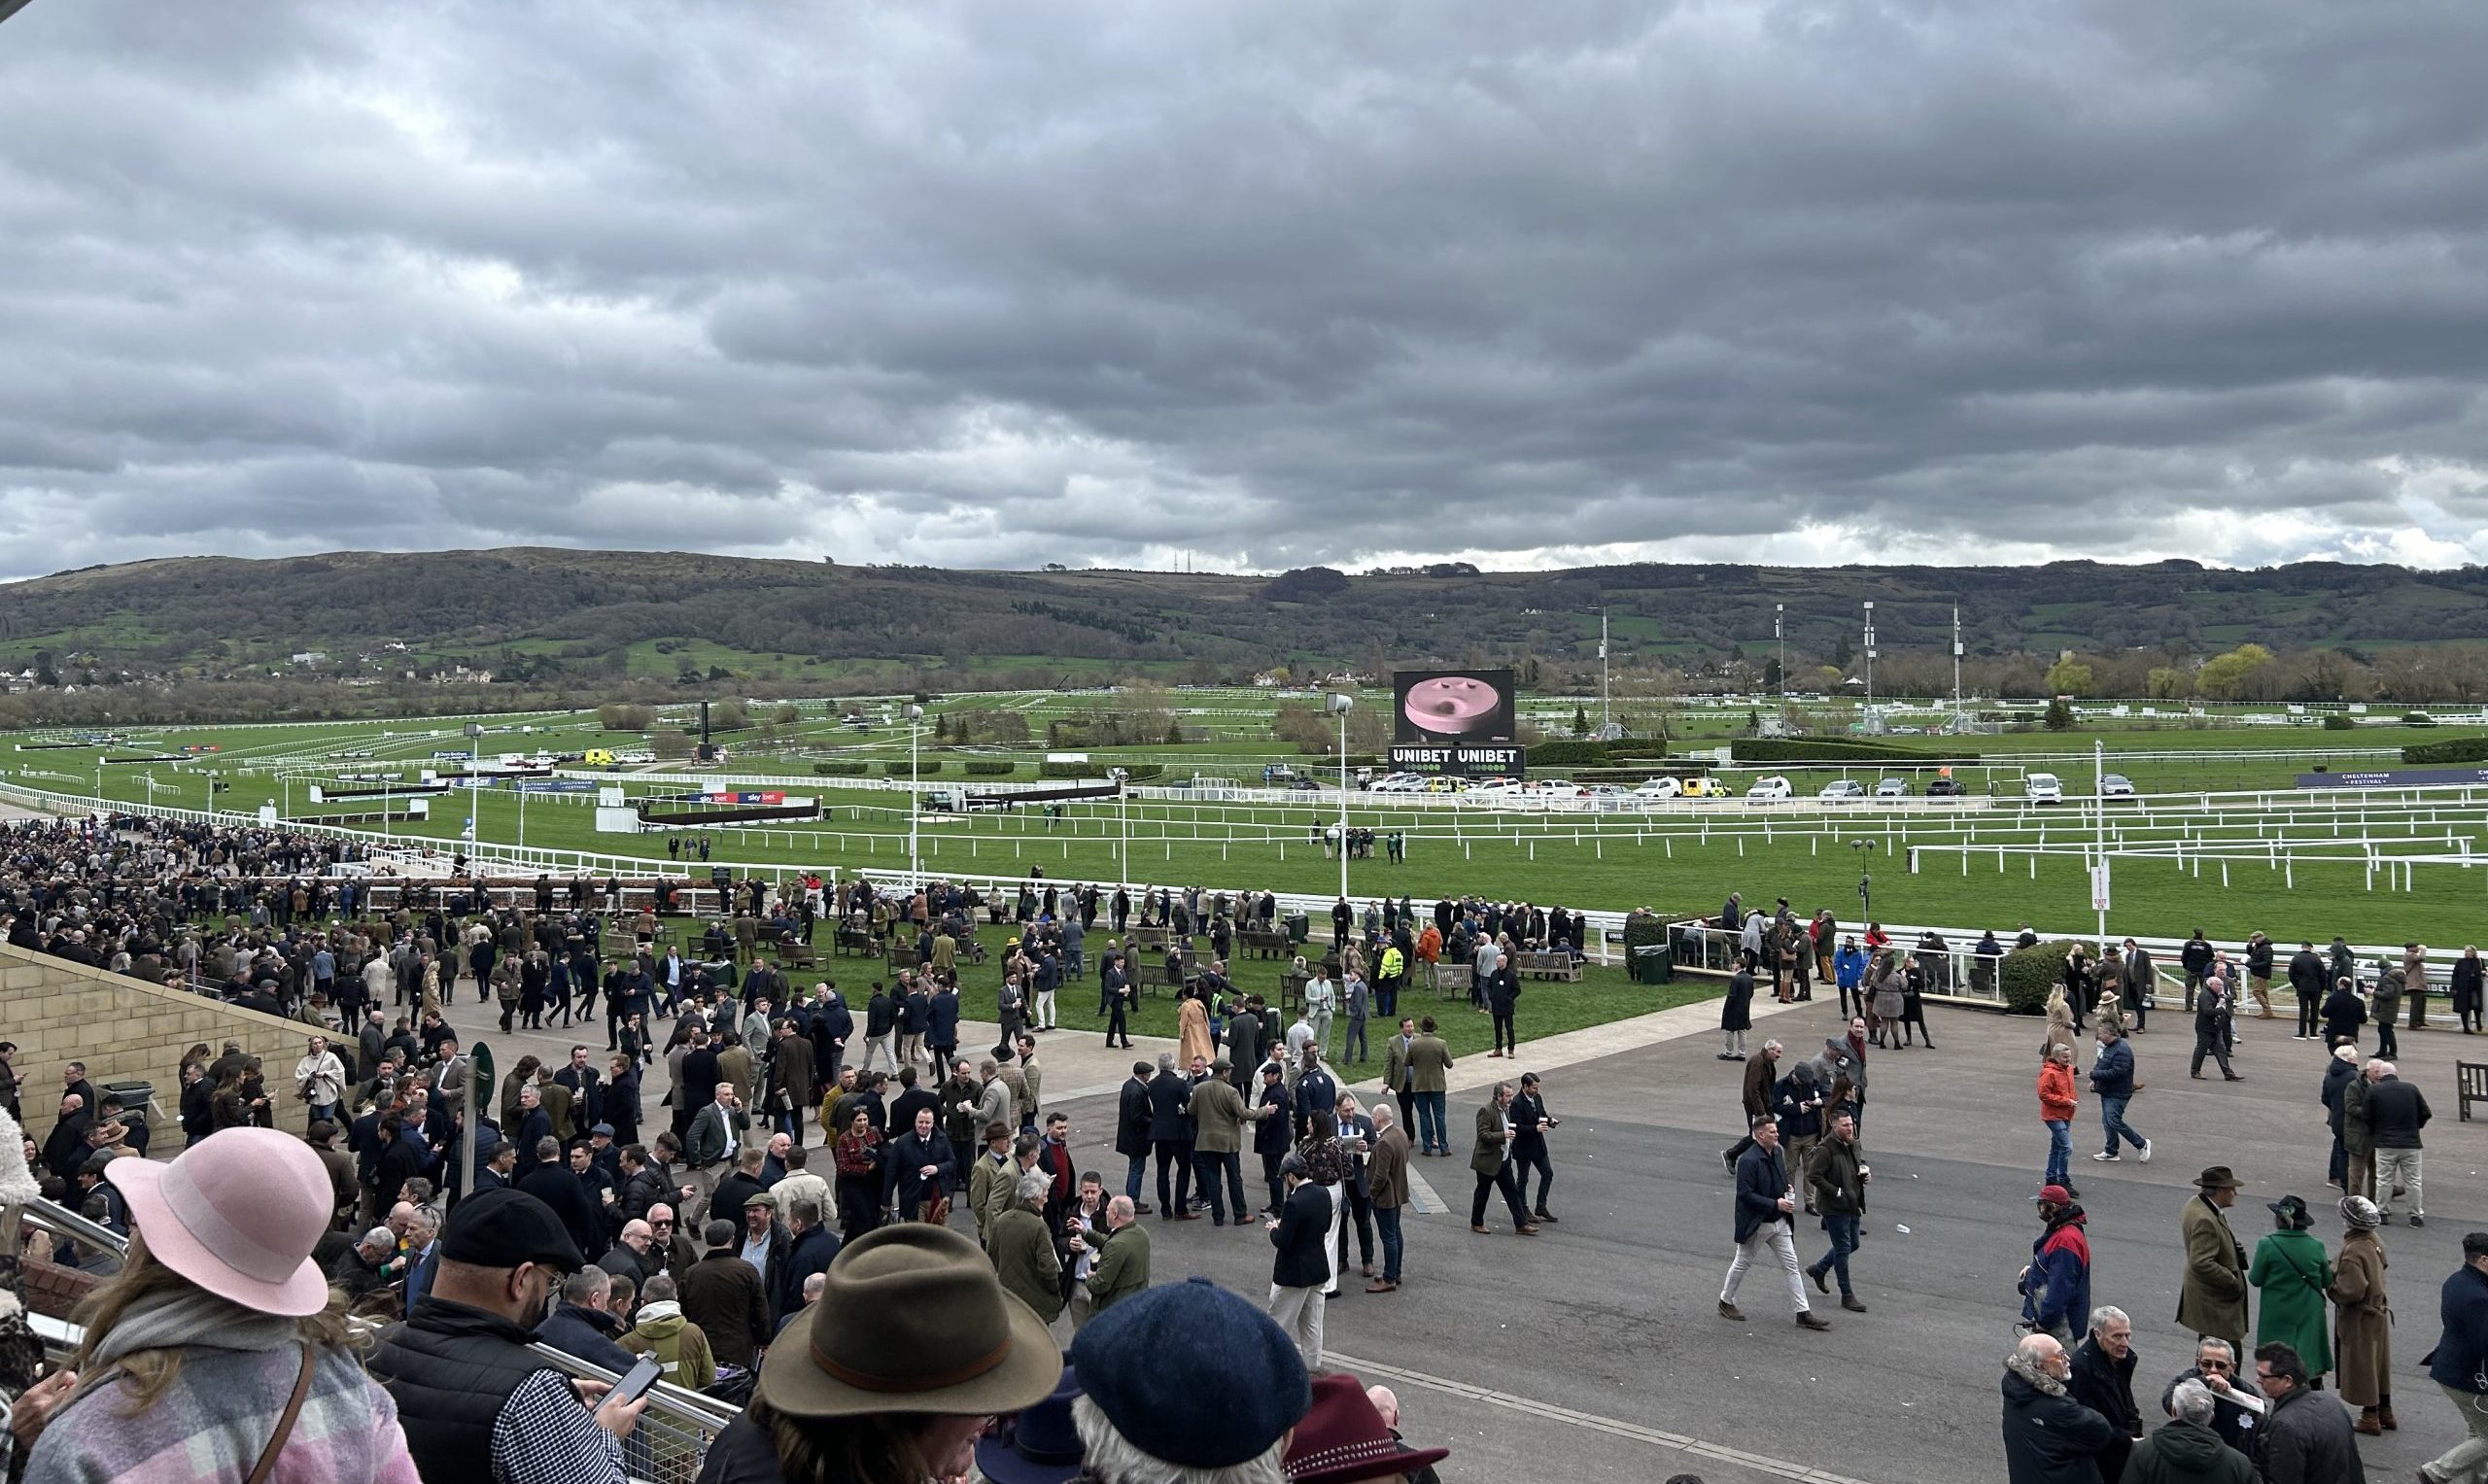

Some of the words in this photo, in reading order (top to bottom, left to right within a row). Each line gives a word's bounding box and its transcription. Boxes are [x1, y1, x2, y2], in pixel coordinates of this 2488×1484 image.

[1394, 748, 1451, 763] UNIBET
[1458, 749, 1517, 763] UNIBET
[699, 795, 713, 804] sky
[747, 793, 761, 802] sky
[2427, 984, 2452, 992] IBET
